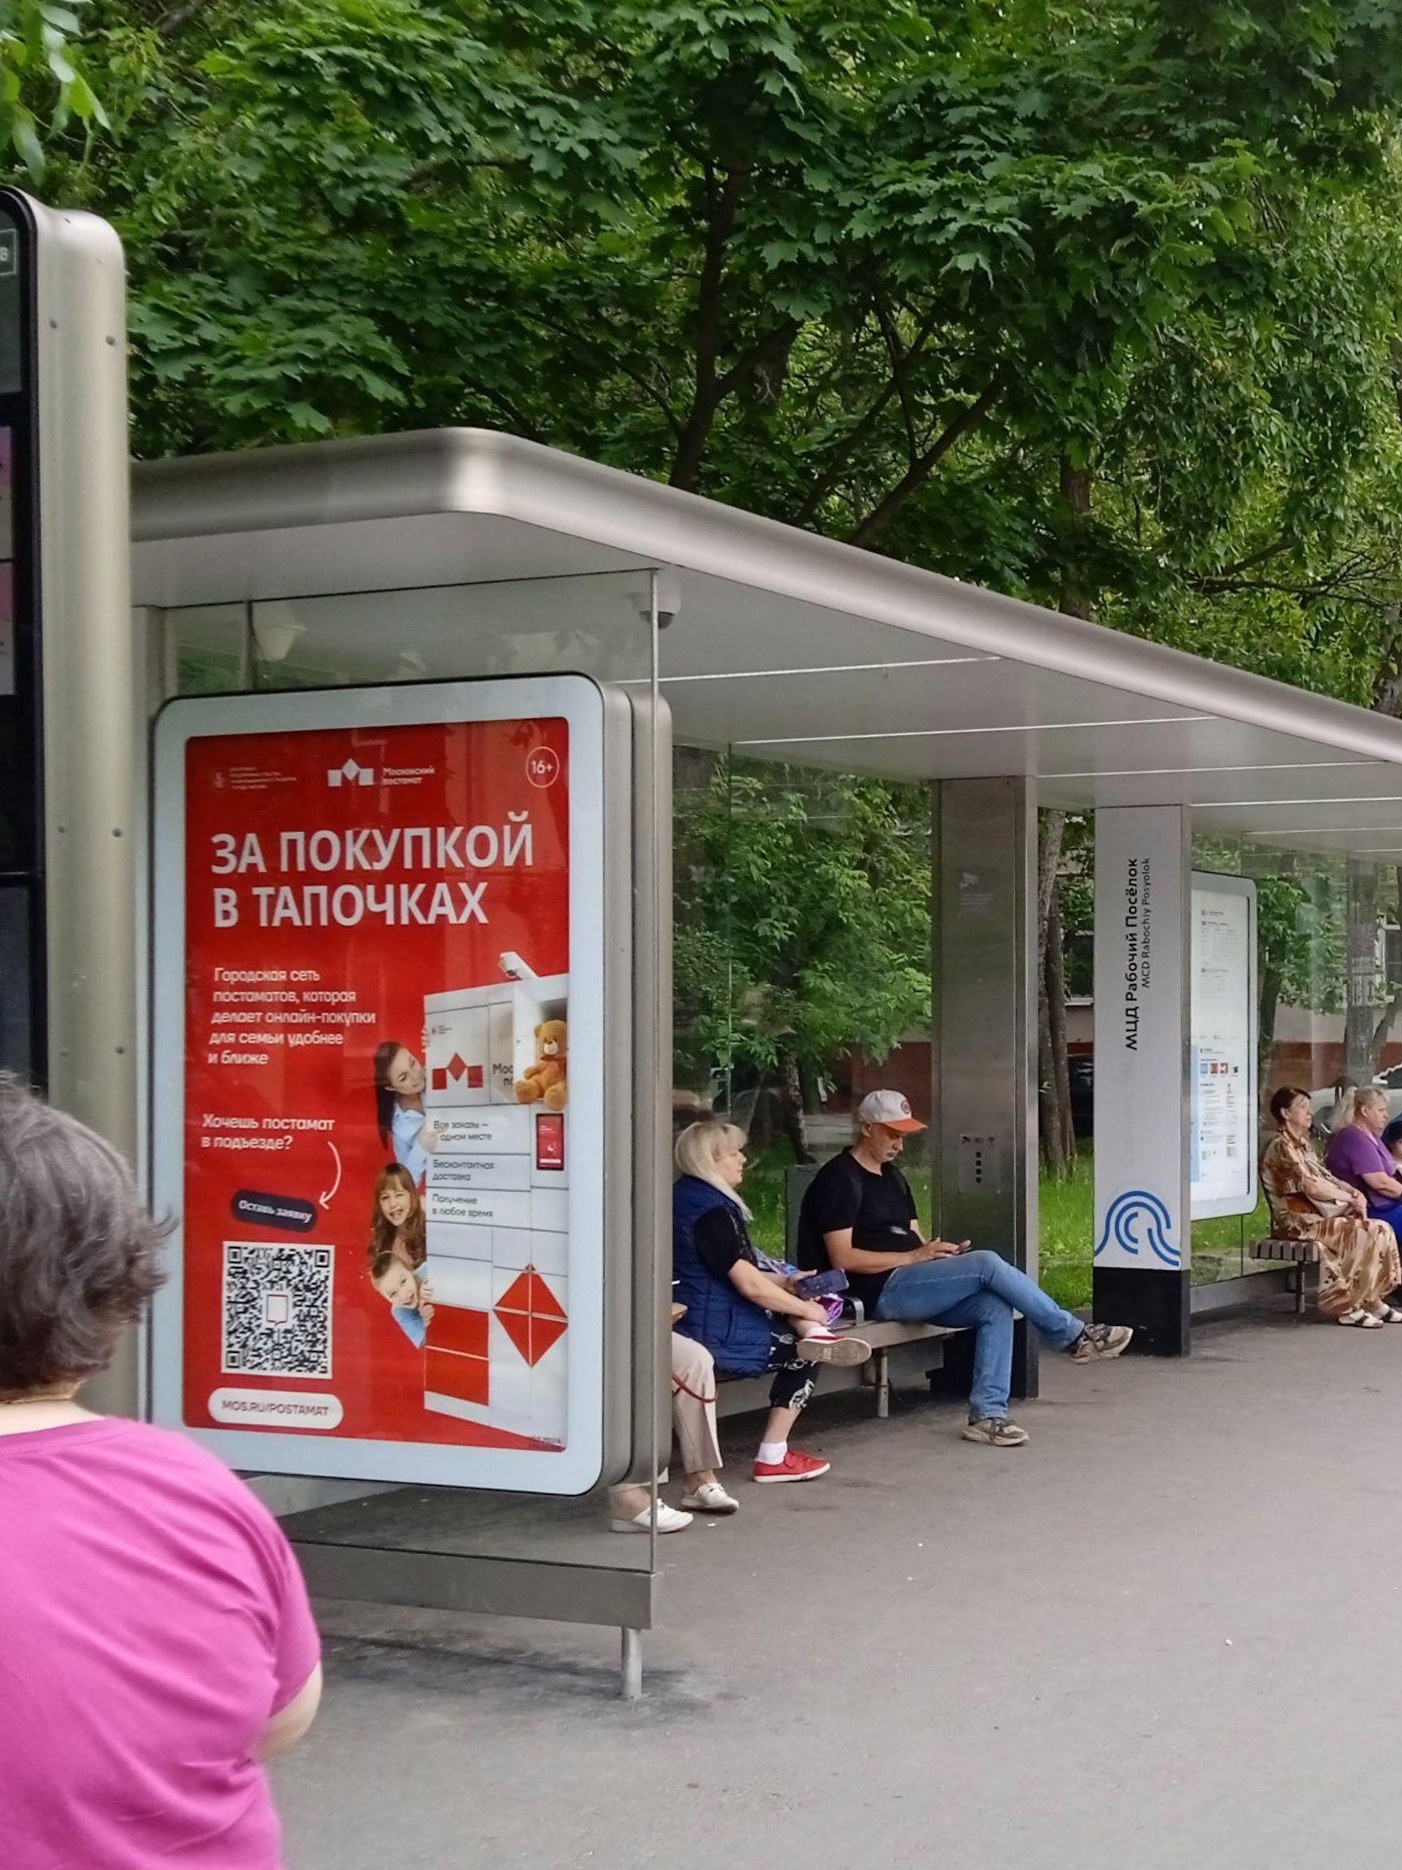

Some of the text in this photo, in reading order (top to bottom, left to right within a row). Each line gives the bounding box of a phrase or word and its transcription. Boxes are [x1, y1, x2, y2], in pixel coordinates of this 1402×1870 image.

[532, 760, 553, 774] 16+
[211, 810, 533, 874] ЗА ПОКУПКОЙ
[1125, 858, 1138, 927] Посёлок
[213, 882, 489, 927] В ТАПОЧКАХ
[1141, 857, 1152, 988] MCD Rabochiy Posyolok
[214, 967, 320, 984] Городская сеть
[1125, 933, 1138, 1001] Рабочий
[213, 991, 356, 1005] постаматов, которая
[211, 1009, 376, 1027] делает онлайн-покупки
[1125, 1006, 1140, 1051] МЦД
[209, 1030, 343, 1047] для семьи удобнее
[208, 1050, 269, 1065] и ближе
[202, 1113, 335, 1130] Хочешь постамат
[201, 1135, 293, 1150] в подъезде?
[238, 1200, 312, 1223] Оставь заявку
[221, 1400, 329, 1416] MOS.RU/POSTAMAT
